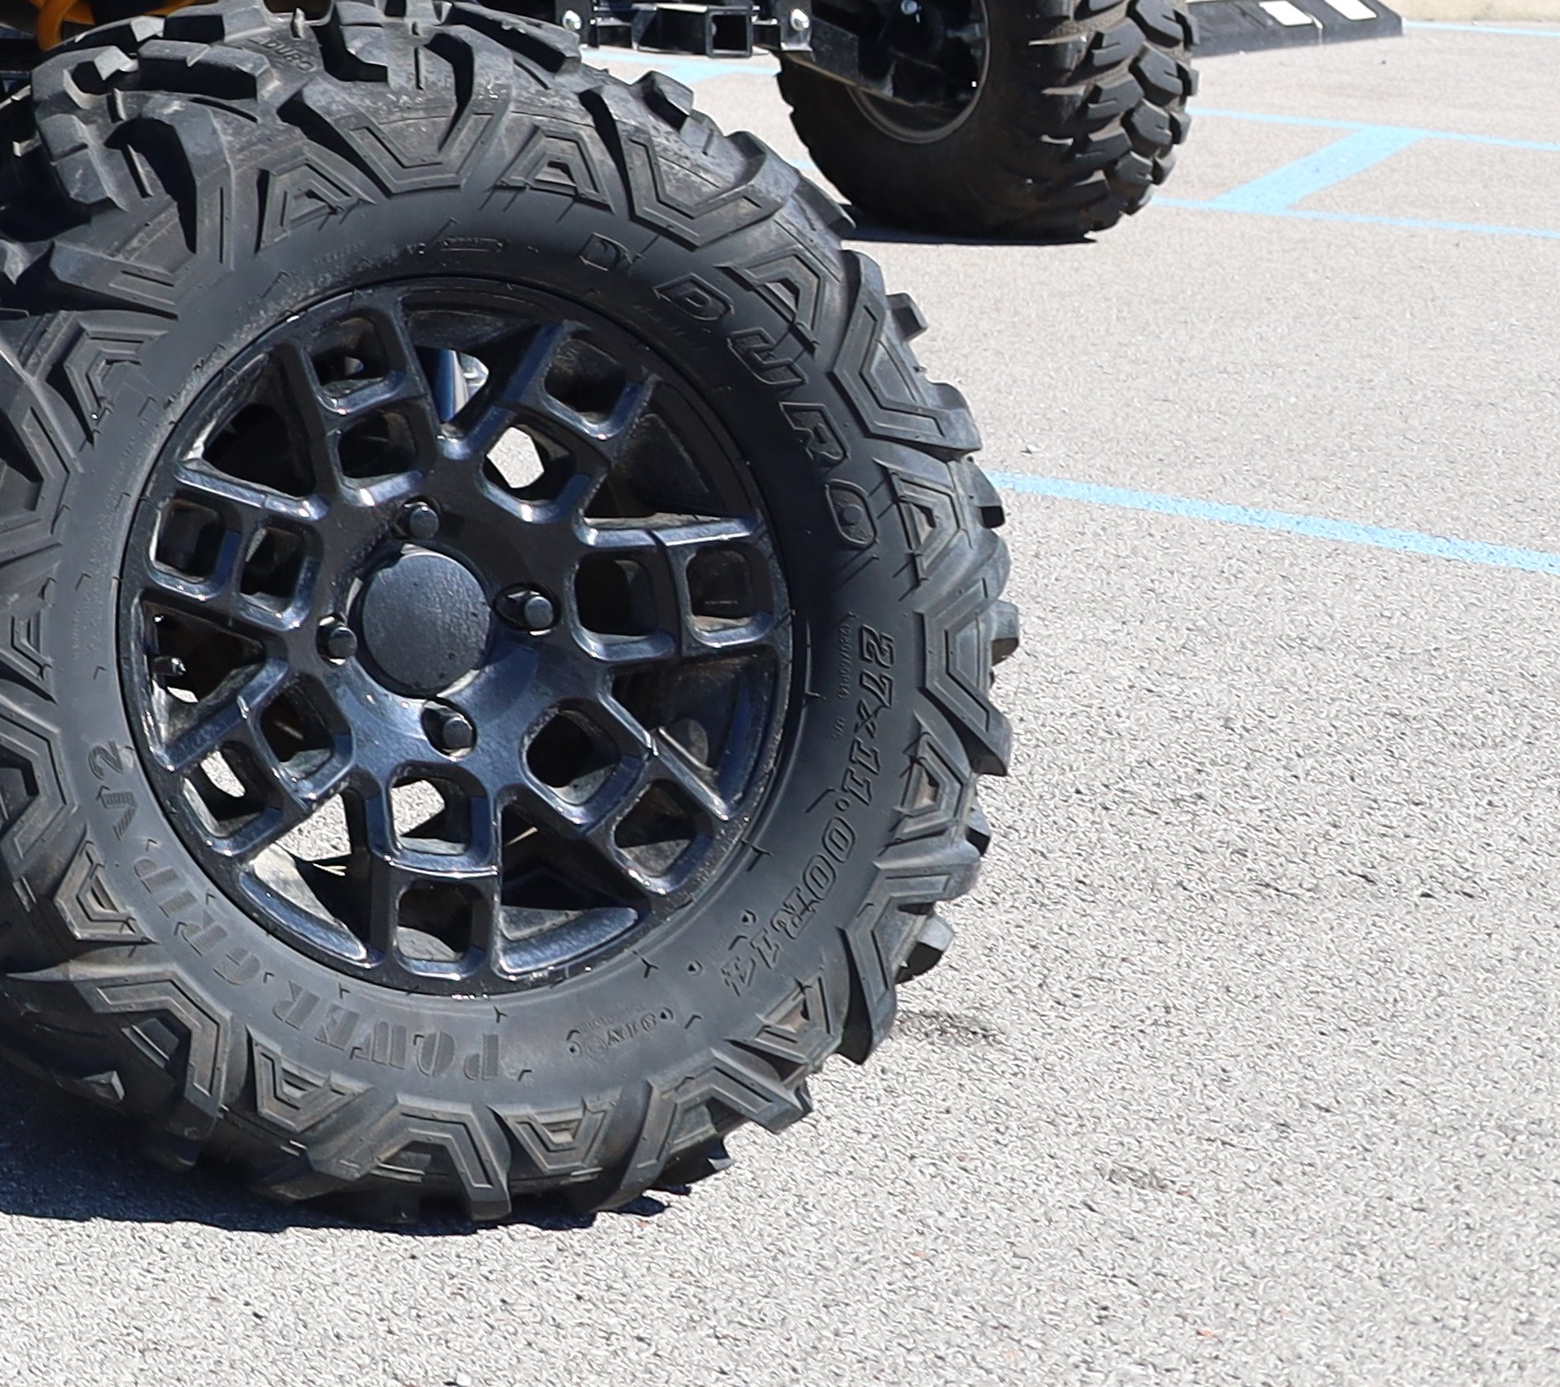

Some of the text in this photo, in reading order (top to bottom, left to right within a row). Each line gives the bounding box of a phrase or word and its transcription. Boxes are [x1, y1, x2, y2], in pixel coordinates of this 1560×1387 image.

[652, 271, 878, 546] DURO
[89, 739, 139, 840] V2
[721, 624, 897, 997] 27x11.00R14
[131, 849, 262, 985] GRIP
[271, 984, 502, 1080] POWER
